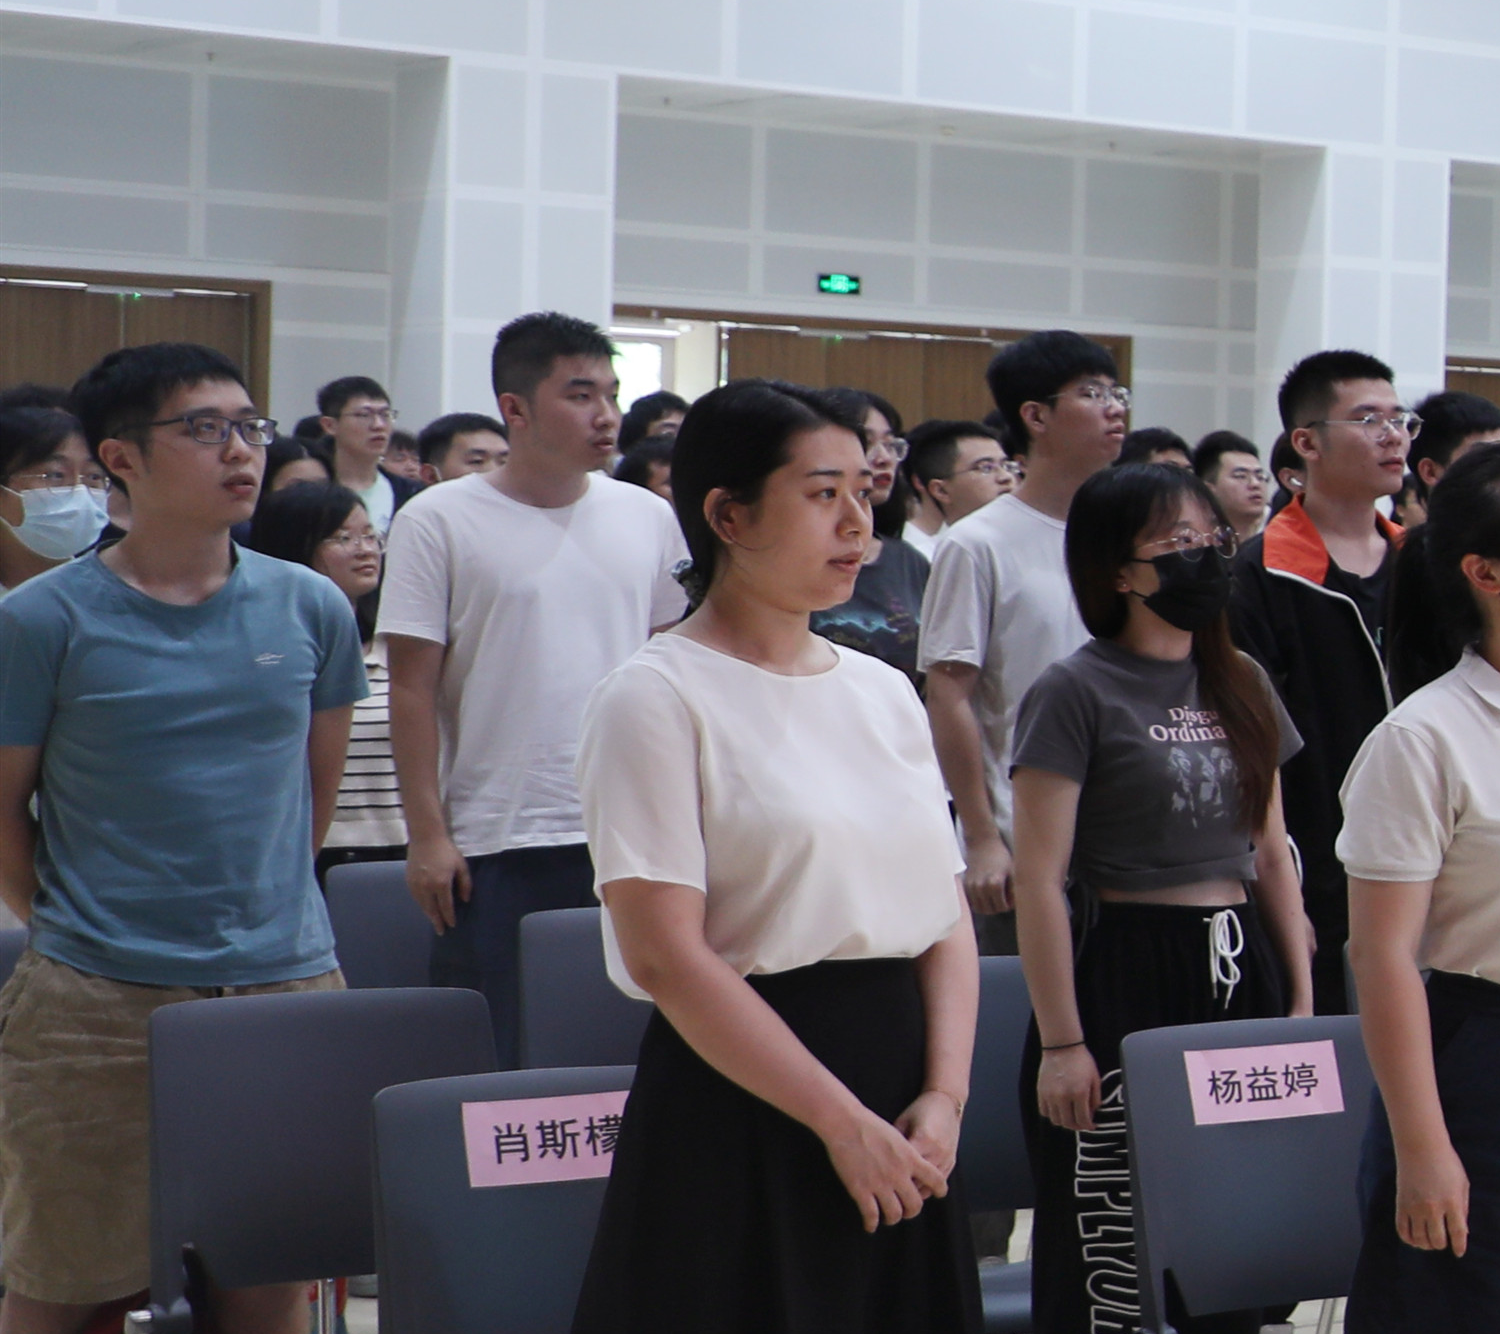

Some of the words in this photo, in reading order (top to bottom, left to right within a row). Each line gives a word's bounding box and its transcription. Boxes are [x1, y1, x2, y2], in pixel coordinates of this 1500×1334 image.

[1208, 1062, 1319, 1105] 杨益婷
[493, 1113, 623, 1165] 肖斯檬
